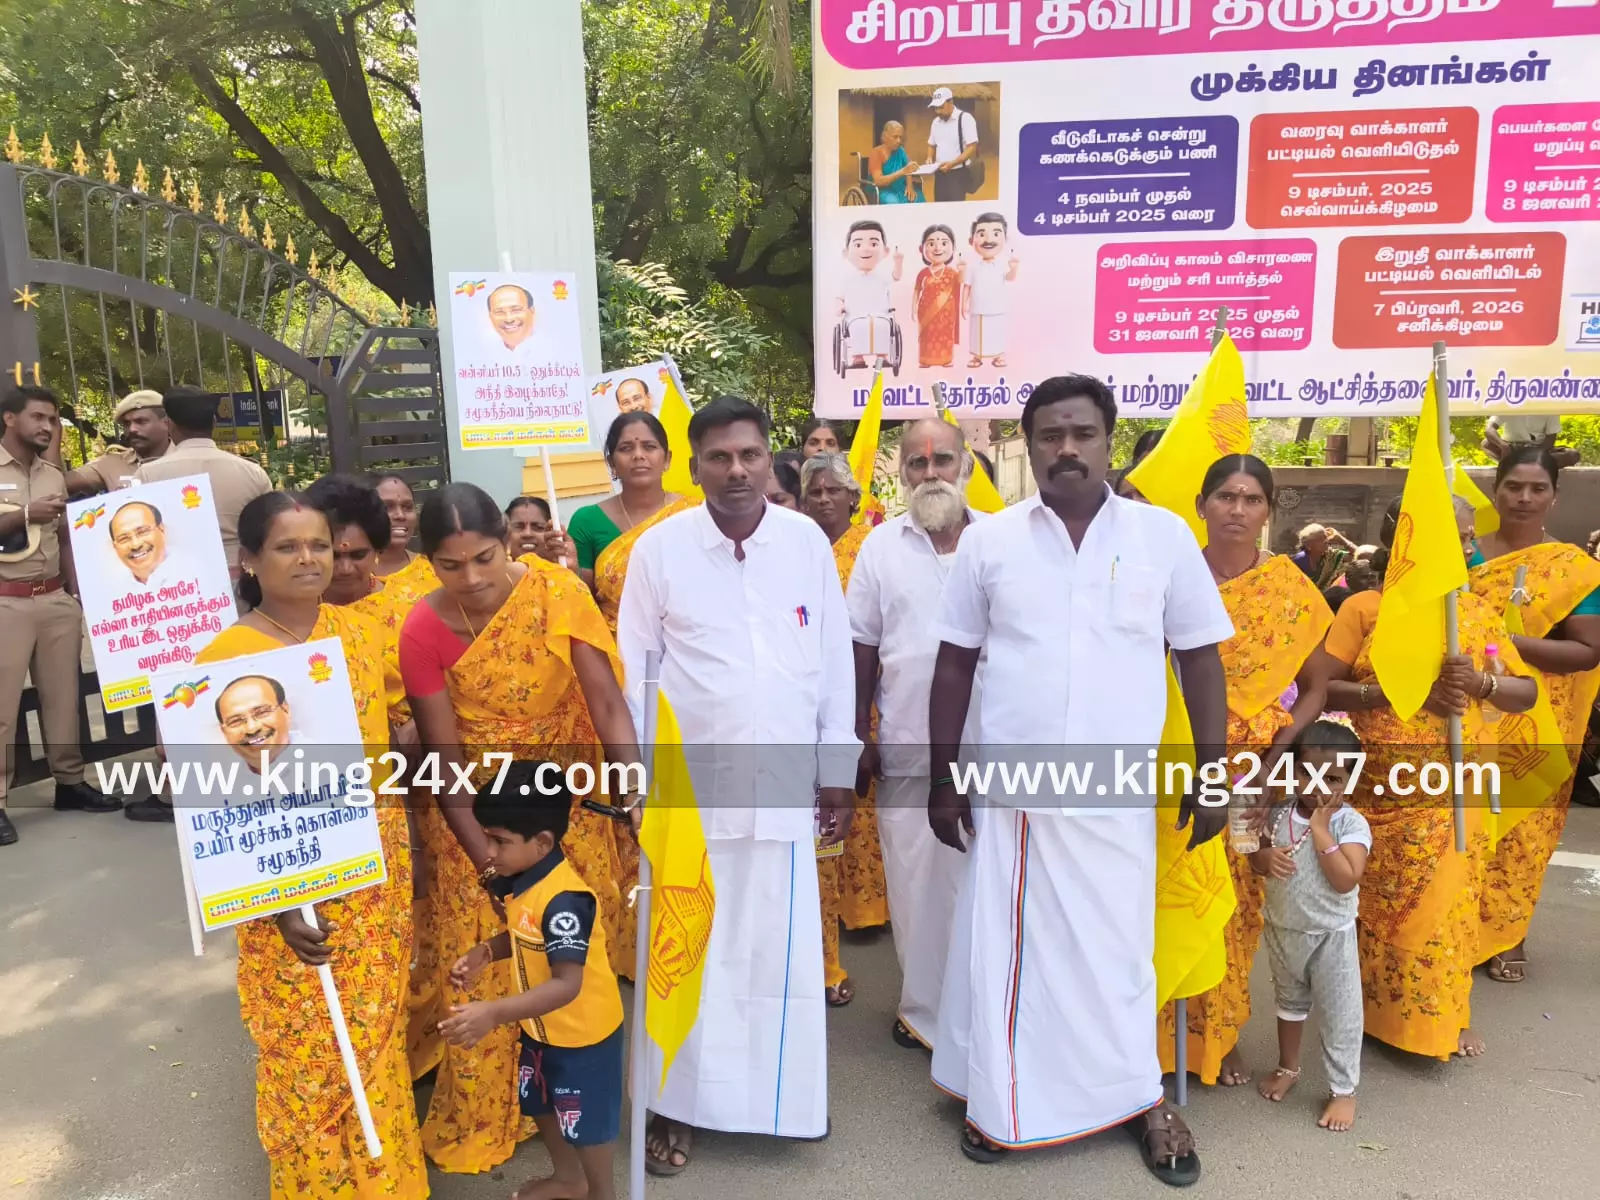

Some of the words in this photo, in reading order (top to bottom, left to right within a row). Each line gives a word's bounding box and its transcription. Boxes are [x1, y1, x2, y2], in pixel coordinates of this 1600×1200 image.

[1191, 62, 1337, 101] முக்கிய
[1353, 50, 1551, 97] தினங்கள்
[1051, 128, 1143, 148] வீடுவீடாகச்
[1147, 126, 1206, 146] சென்று
[1280, 125, 1344, 140] வரைவு
[1350, 117, 1449, 137] வாக்காளர்
[1040, 146, 1173, 165] கணக்கெடுக்கும்
[1179, 145, 1217, 159] பணி
[1267, 143, 1336, 162] பட்டியல்
[1341, 139, 1460, 160] வெளியிடுதல்
[1533, 138, 1584, 158] மறுப்பு
[1288, 186, 1301, 199] 9
[1380, 182, 1433, 196] 2025
[1504, 179, 1517, 192] 9
[1523, 176, 1588, 194] டிசம்பர்
[1057, 192, 1070, 204] 4
[1075, 188, 1140, 208] நவம்பர்
[1145, 186, 1192, 205] முதல்
[1502, 198, 1516, 210] 8
[1522, 194, 1591, 210] ஜனவரி
[1034, 212, 1046, 225] 4
[1051, 209, 1110, 227] டிசம்பர்
[1115, 209, 1166, 223] 2025
[1171, 208, 1215, 223] வரை
[1280, 200, 1438, 218] செவ்வாய்க்கிழமை
[1100, 252, 1169, 271] அறிவிப்பு
[1175, 252, 1222, 266] காலம்
[1227, 251, 1313, 267] விசாரணை
[1375, 246, 1429, 267] இறுதி
[1435, 244, 1535, 261] வாக்காளர்
[1128, 273, 1181, 292] மற்றும்
[1186, 272, 1210, 286] சரி
[1215, 270, 1283, 288] பார்த்தல்
[1365, 267, 1435, 284] பட்டியல்
[1440, 263, 1542, 281] வெளியிடல்
[1115, 311, 1127, 323] 9
[1133, 308, 1192, 325] டிசம்பர்
[1253, 305, 1300, 323] முதல்
[1373, 304, 1385, 316] 7
[1472, 300, 1524, 314] 2026
[1108, 329, 1129, 342] 31
[1135, 325, 1199, 341] ஜனவரி
[1205, 326, 1255, 340] 226
[1260, 326, 1304, 342] வரை
[1397, 317, 1504, 335] சனிக்கிழமை
[502, 365, 521, 378] 10.5
[853, 385, 929, 407] மவட்ட
[112, 592, 155, 615] தமிழக
[157, 578, 201, 601] அரசே!
[91, 618, 129, 637] எல்லா
[131, 592, 231, 627] சாதியினருக்கும்
[107, 634, 139, 653] உரிய
[142, 625, 165, 645] இட
[191, 792, 275, 832] மருத்துவர்
[194, 830, 234, 860] உயிர்
[239, 816, 292, 853] மூச்சுக்
